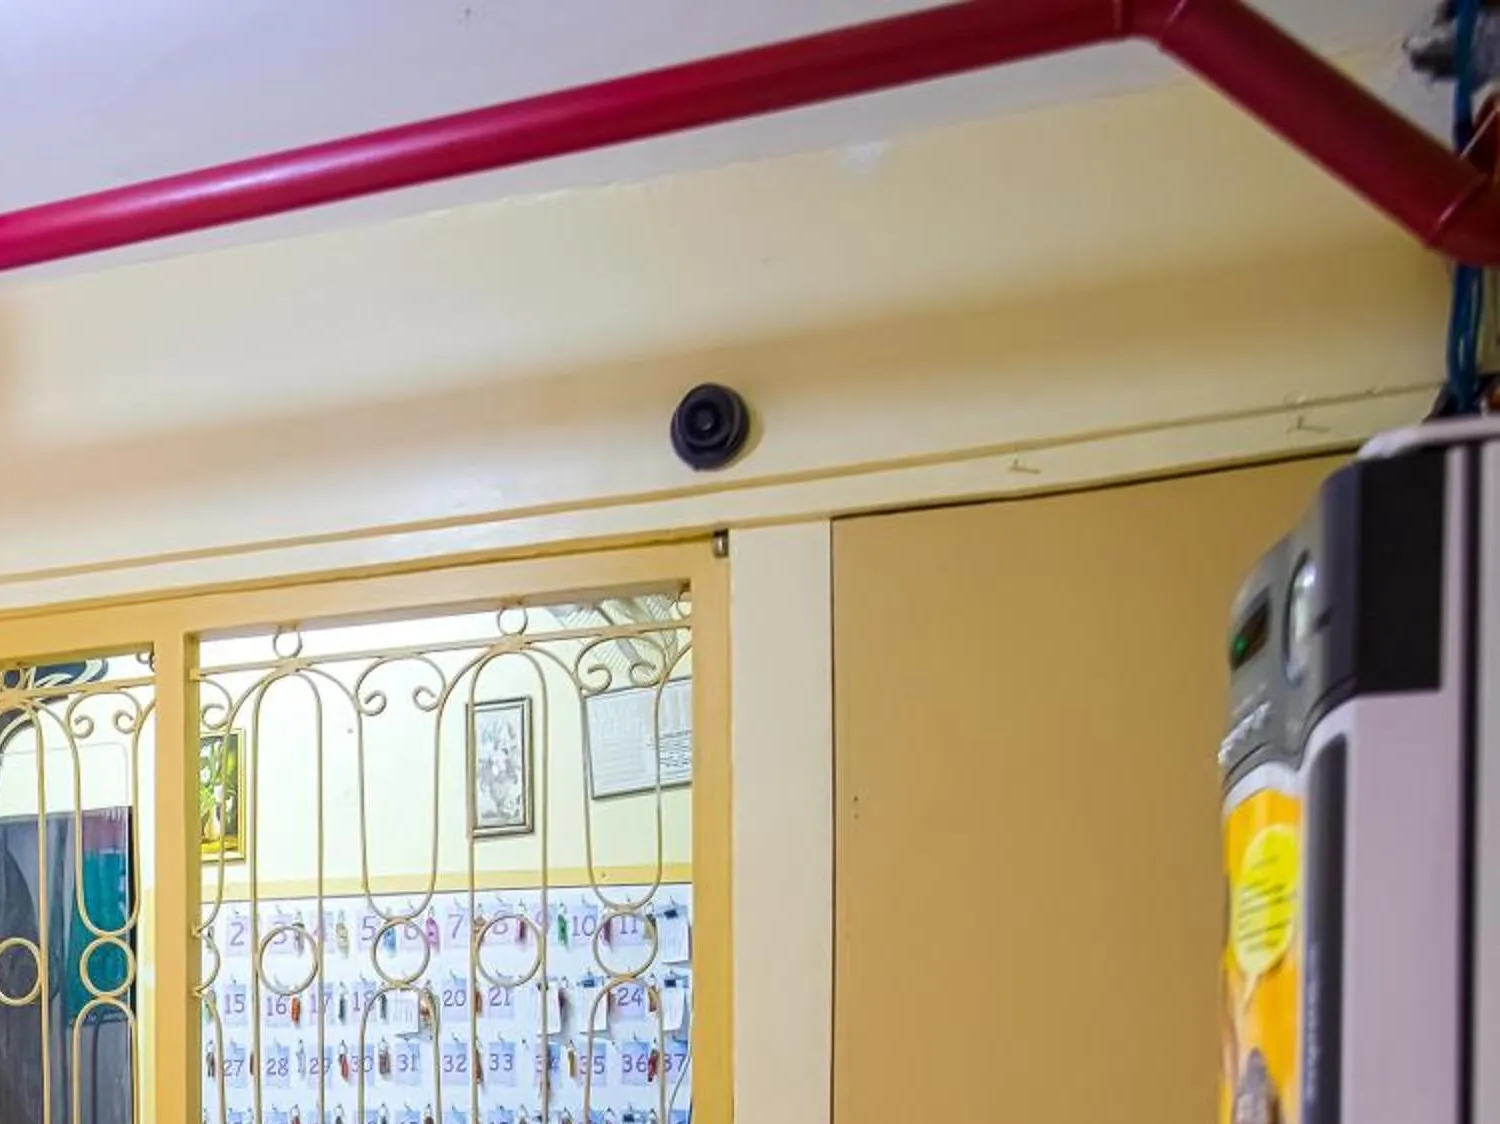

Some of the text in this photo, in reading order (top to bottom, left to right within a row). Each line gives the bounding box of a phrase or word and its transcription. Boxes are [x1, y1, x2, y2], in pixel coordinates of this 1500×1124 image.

[229, 921, 245, 946] 2
[361, 915, 376, 940] 5
[449, 914, 464, 938] 7
[571, 915, 597, 937] 10
[224, 993, 245, 1015] 15
[266, 994, 287, 1016] 16
[443, 989, 467, 1007] 20
[488, 986, 511, 1007] 21
[617, 987, 642, 1007] 24
[223, 1059, 244, 1077] 27
[266, 1058, 289, 1077] 28
[398, 1053, 417, 1072] 31
[443, 1054, 467, 1073] 32
[489, 1053, 513, 1071] 33
[622, 1053, 648, 1073] 36
